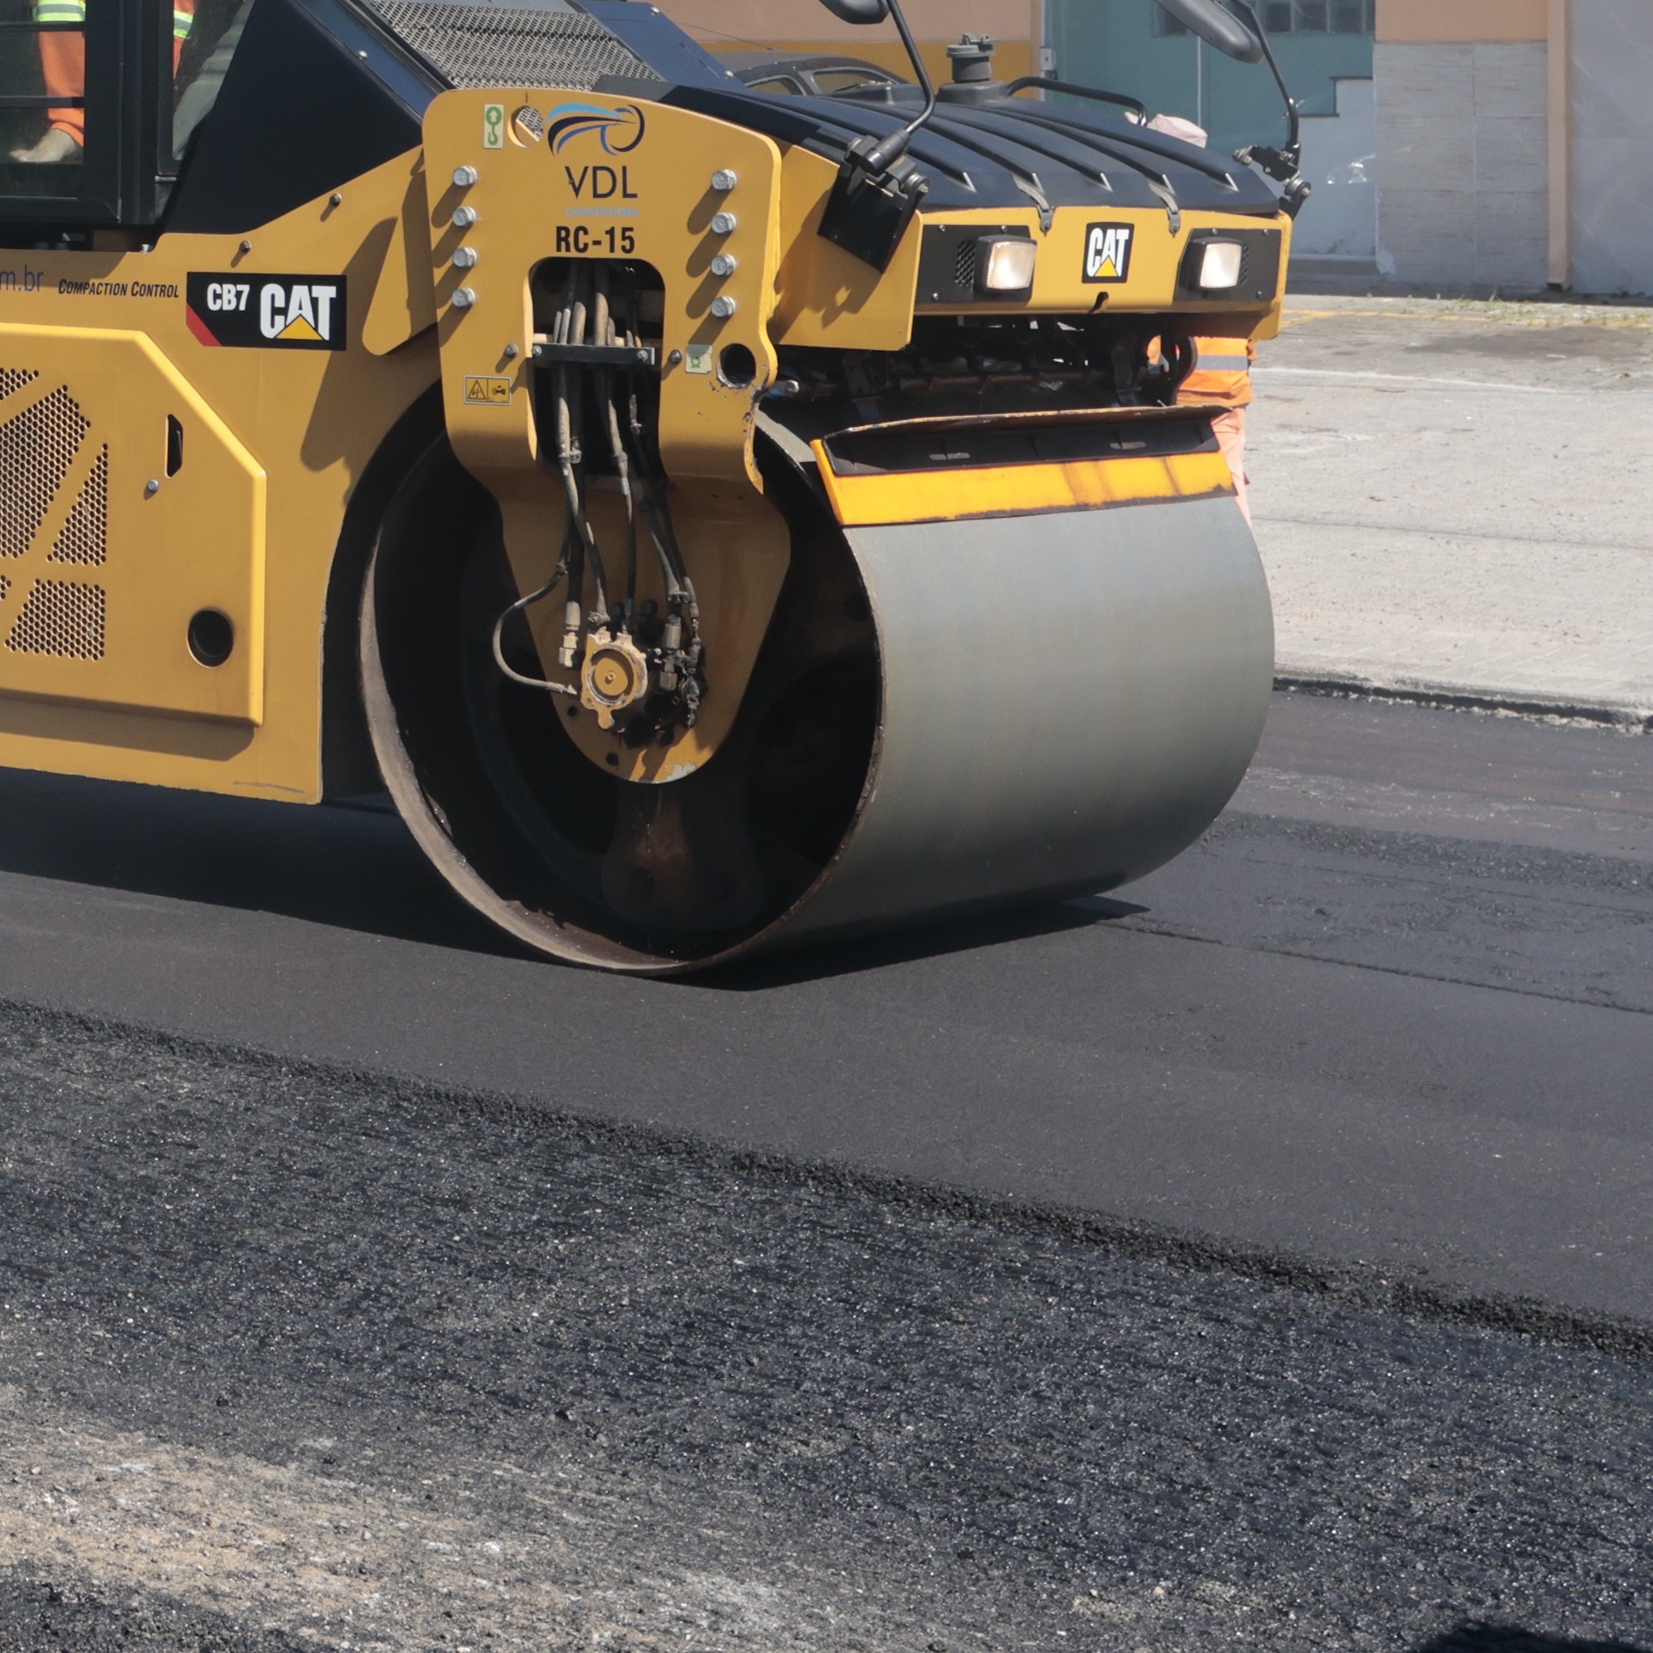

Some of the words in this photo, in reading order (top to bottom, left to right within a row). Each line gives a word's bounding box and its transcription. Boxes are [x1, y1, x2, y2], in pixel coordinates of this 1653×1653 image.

[564, 165, 638, 199] VDL
[556, 225, 635, 254] RC-15
[1087, 228, 1130, 277] CAT
[58, 279, 127, 297] COMPACTION
[131, 281, 180, 298] CONTROL
[207, 283, 250, 311] CB7
[260, 283, 336, 341] CAT
